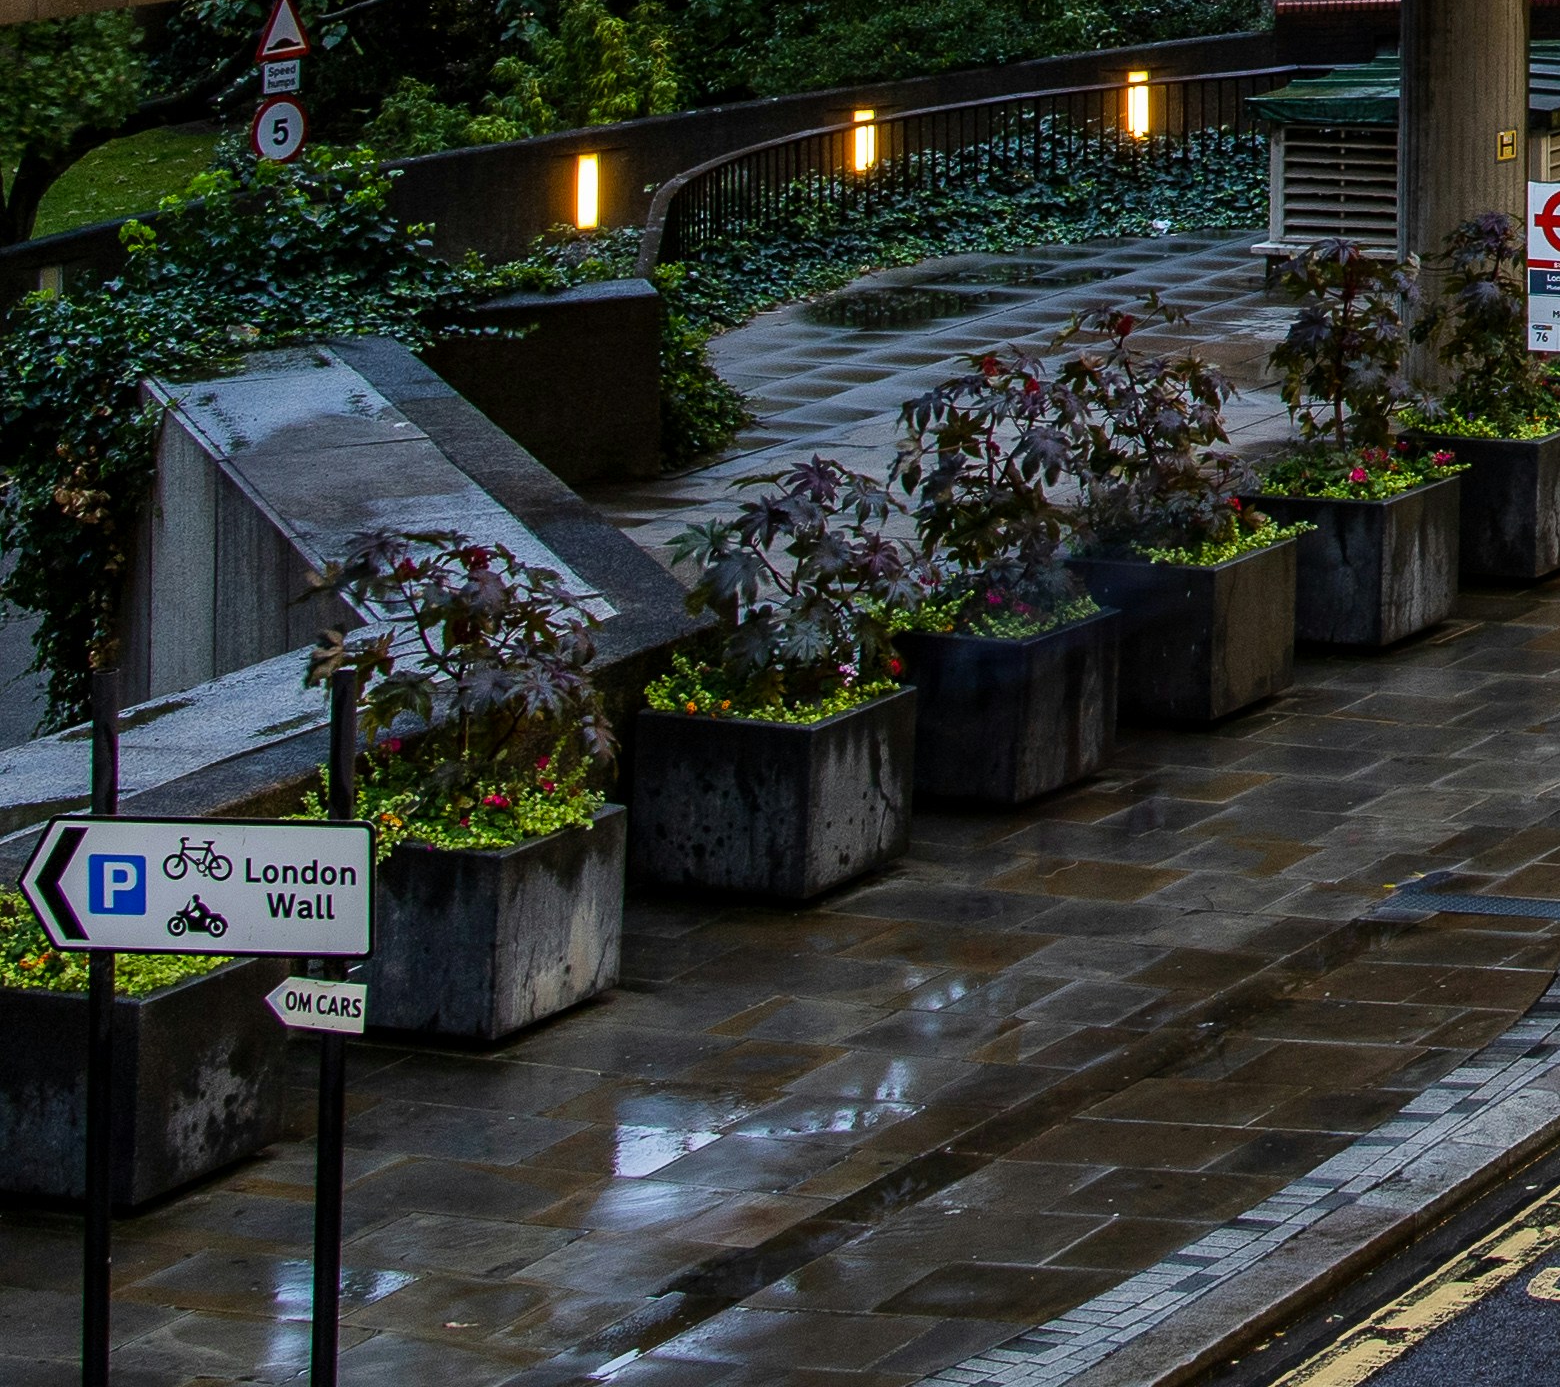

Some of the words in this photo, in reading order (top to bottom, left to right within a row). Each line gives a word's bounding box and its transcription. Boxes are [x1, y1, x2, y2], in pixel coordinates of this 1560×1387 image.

[267, 77, 296, 90] humps
[268, 64, 296, 78] Speed
[272, 117, 289, 146] 5
[1536, 331, 1549, 342] 76
[103, 861, 138, 909] P
[246, 857, 357, 886] London
[266, 892, 336, 920] Wall
[285, 990, 312, 1013] OM
[316, 994, 363, 1018] CARS
